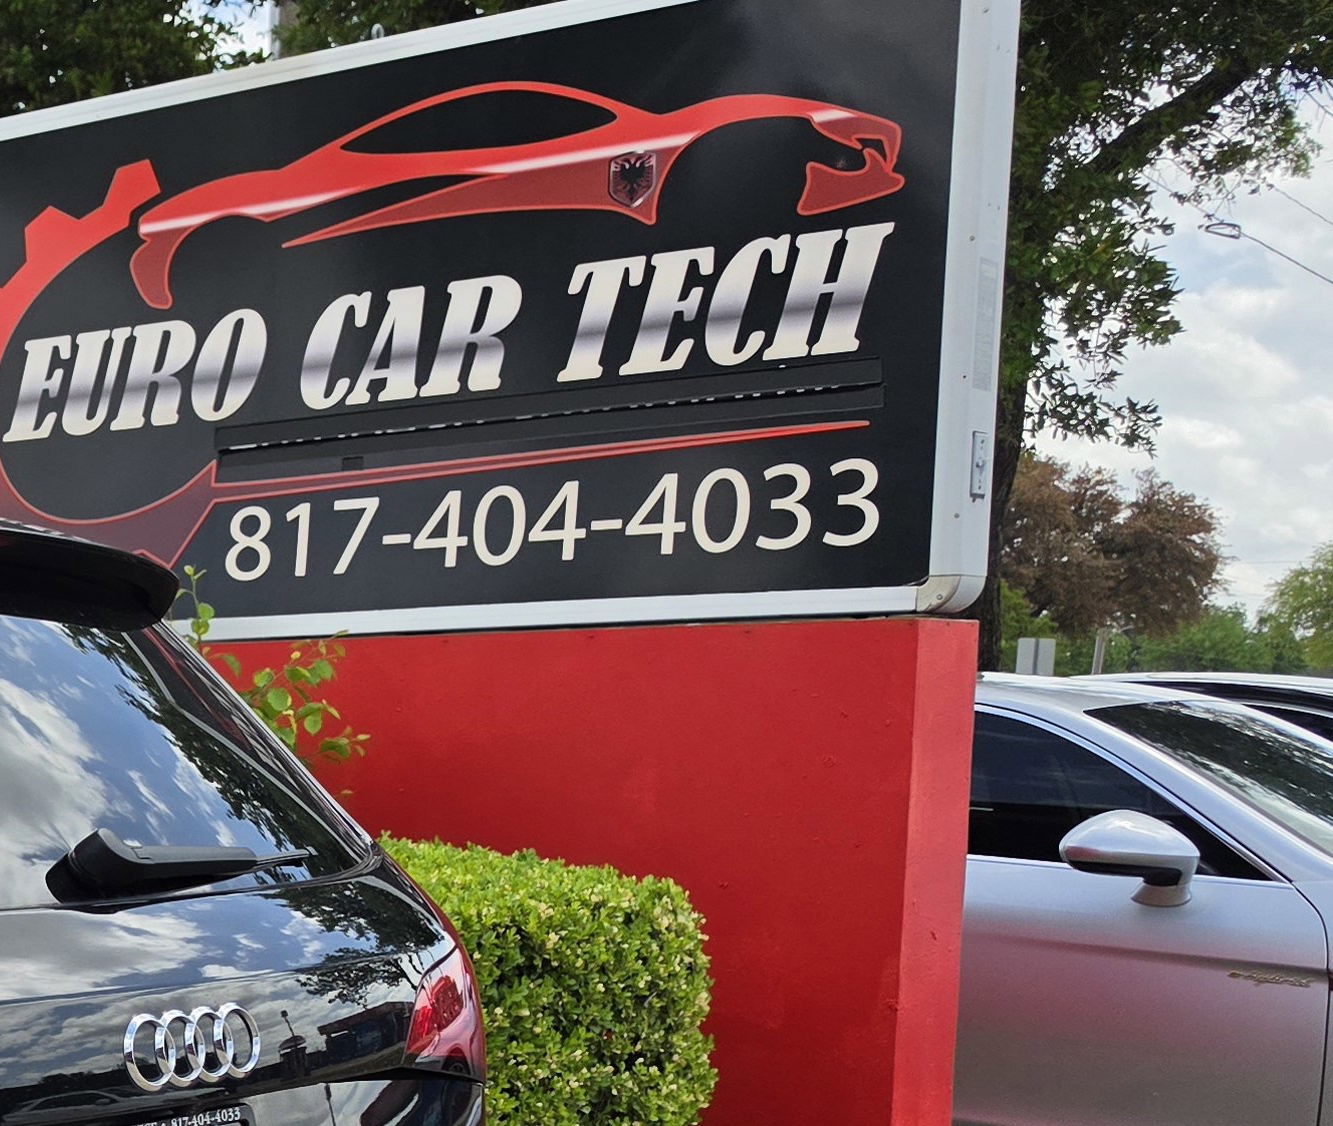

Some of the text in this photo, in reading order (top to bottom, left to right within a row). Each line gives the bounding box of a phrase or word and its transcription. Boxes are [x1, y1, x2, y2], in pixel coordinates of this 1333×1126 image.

[3, 221, 894, 443] EURO CAR TECH
[224, 456, 881, 581] 817-404-4033
